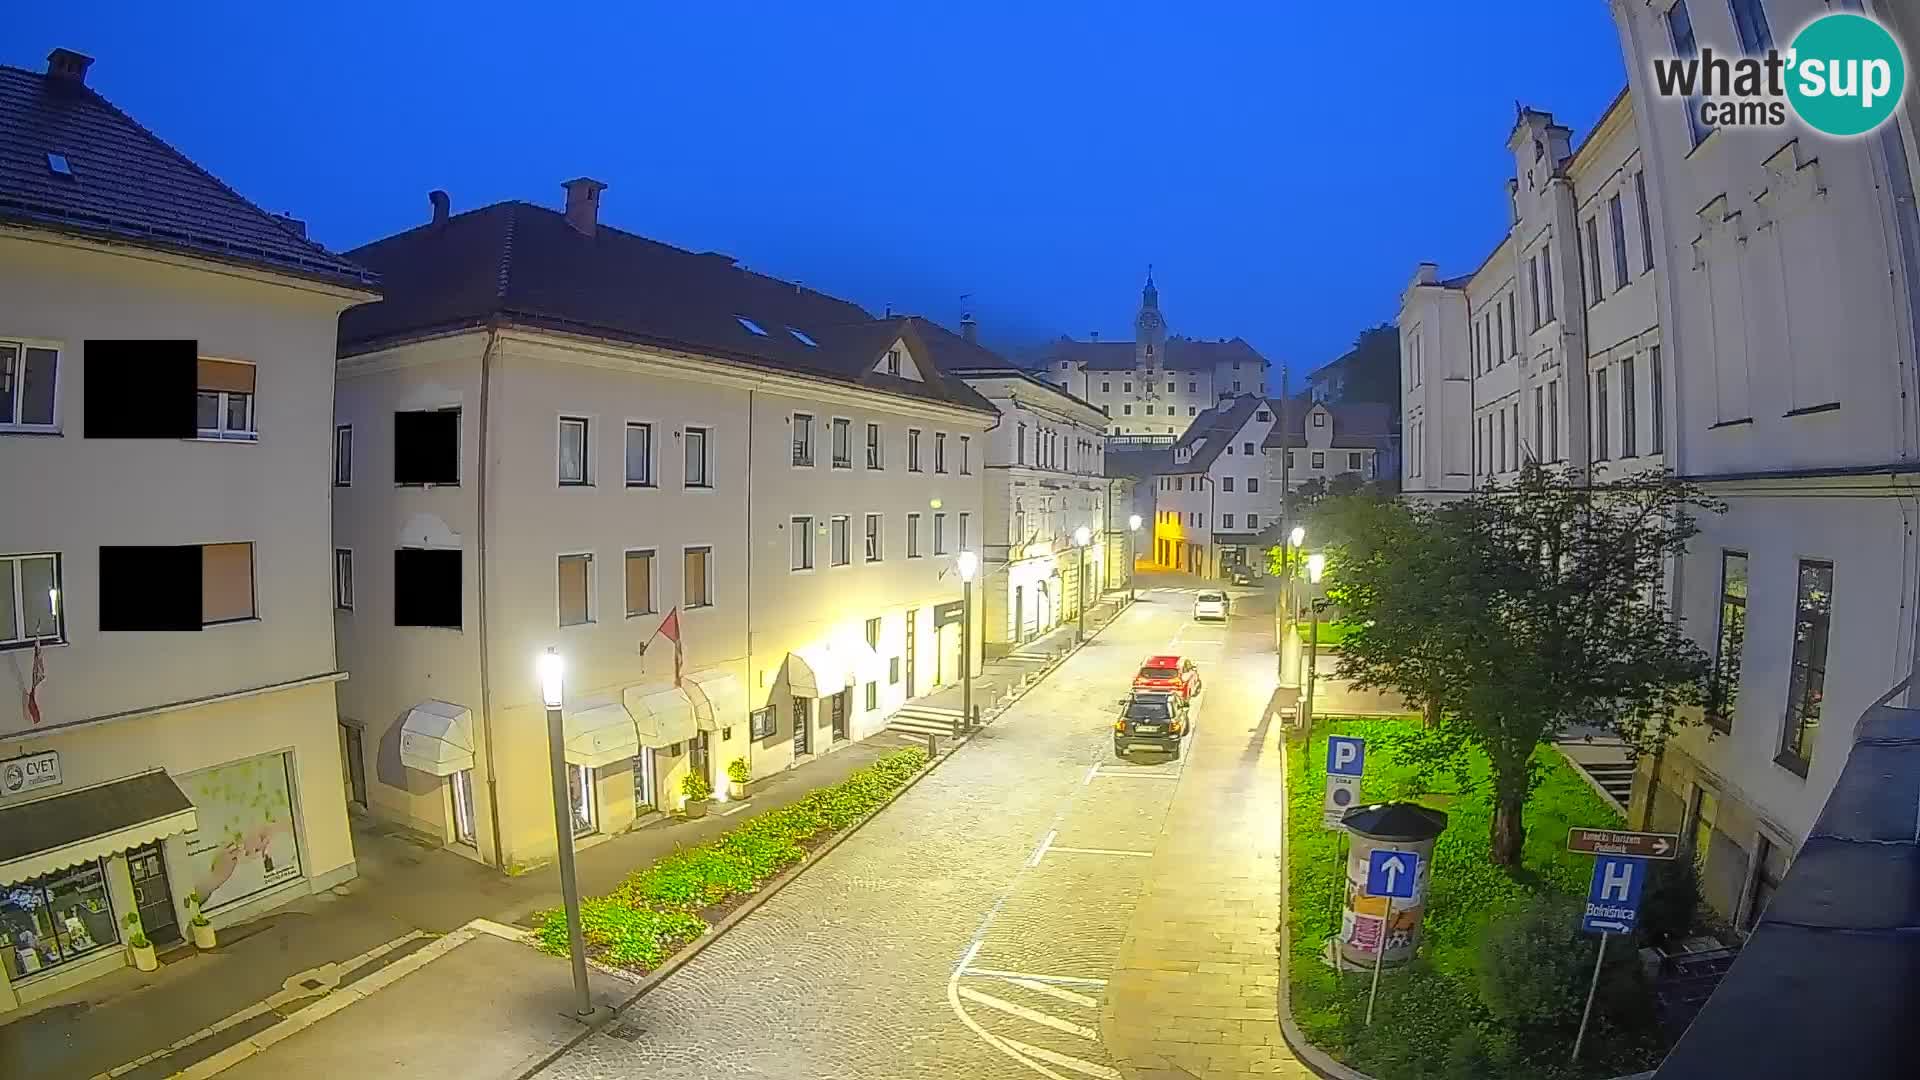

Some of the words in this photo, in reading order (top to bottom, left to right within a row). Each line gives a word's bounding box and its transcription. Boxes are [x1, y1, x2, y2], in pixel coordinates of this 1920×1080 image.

[26, 758, 55, 775] CVET
[1335, 742, 1356, 769] P
[1601, 862, 1633, 901] H
[1586, 903, 1635, 920] Bolnišnica
